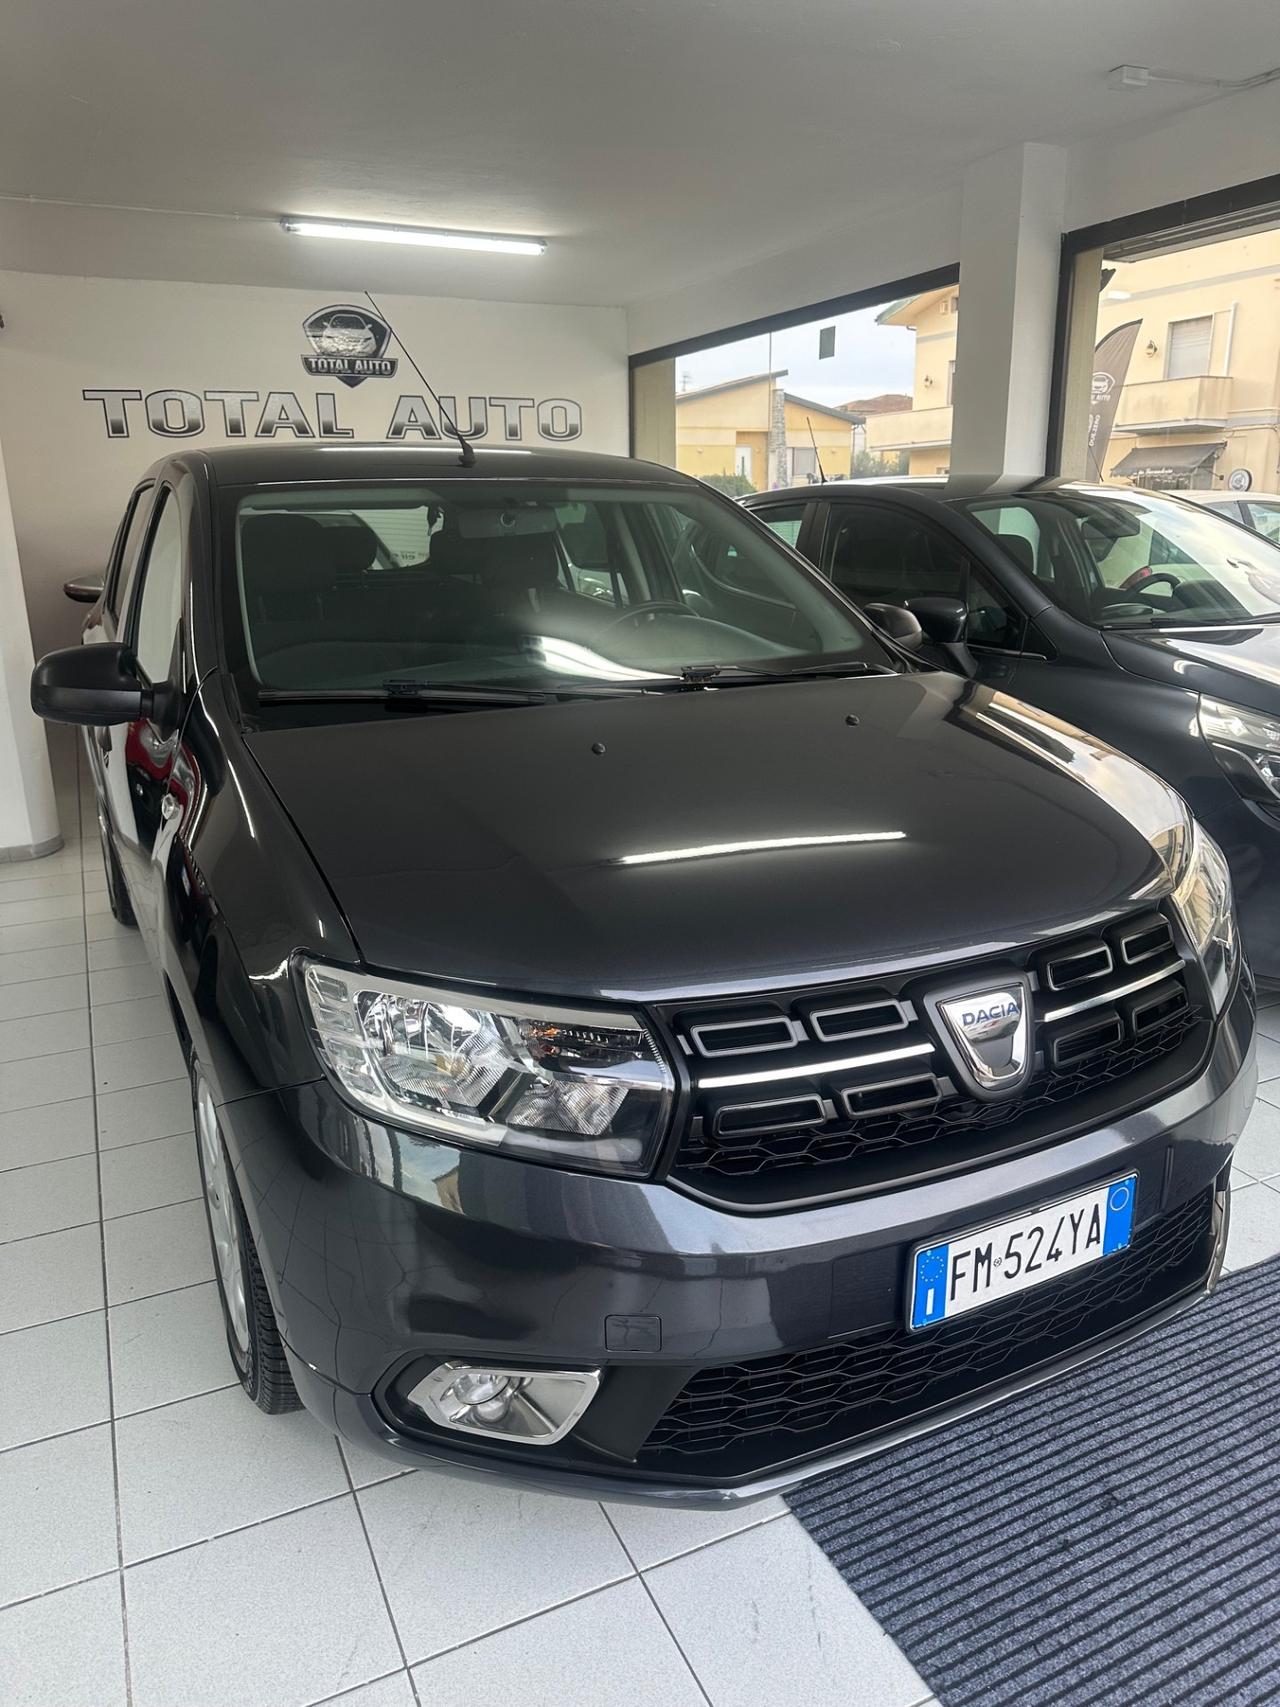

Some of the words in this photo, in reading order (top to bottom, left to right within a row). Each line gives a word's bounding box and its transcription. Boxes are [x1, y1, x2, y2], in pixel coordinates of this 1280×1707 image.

[308, 358, 351, 374] TOTAL
[354, 360, 392, 375] AUTO
[82, 388, 354, 439] TOTAL
[386, 394, 583, 442] AUTO
[962, 1002, 1020, 1026] DACIA
